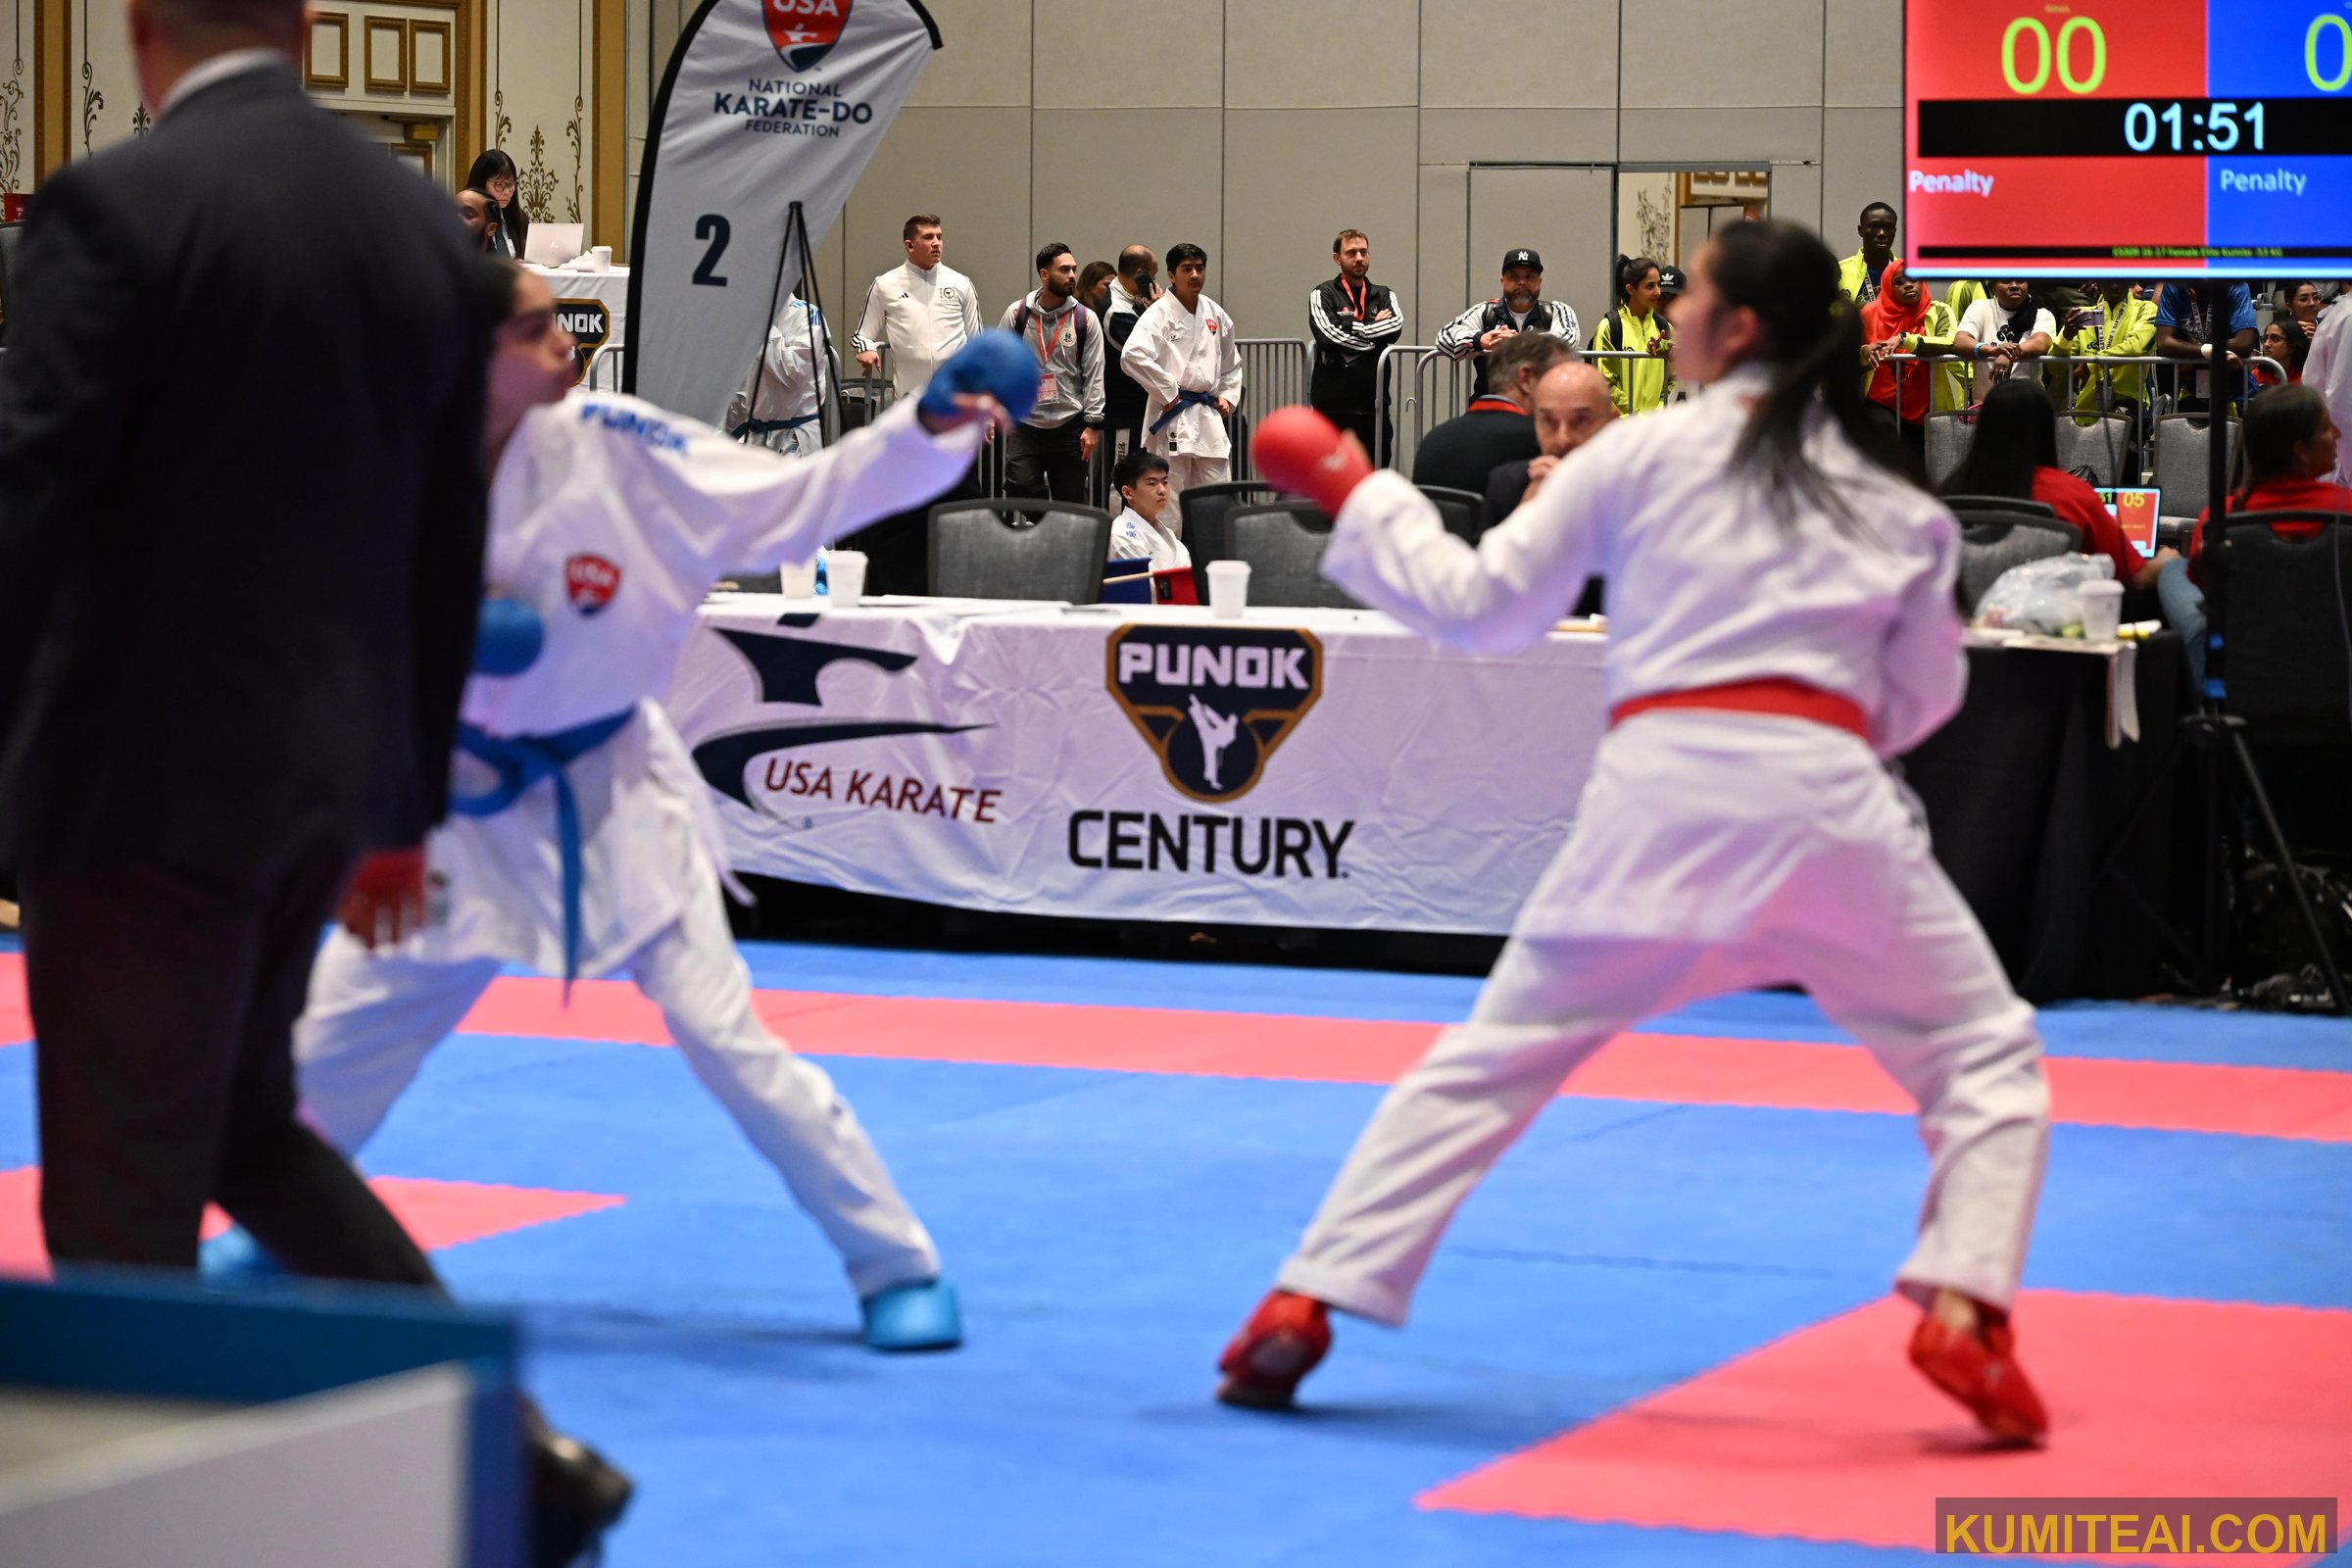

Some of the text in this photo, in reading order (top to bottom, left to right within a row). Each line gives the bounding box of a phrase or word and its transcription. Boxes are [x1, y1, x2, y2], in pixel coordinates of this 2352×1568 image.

[773, 0, 839, 18] USA
[2001, 16, 2107, 95] 00
[749, 78, 843, 98] NATIONAL
[713, 92, 873, 124] KARATE-DO
[745, 119, 840, 137] FEDERATION
[2124, 102, 2265, 152] 01:51
[1909, 169, 1993, 197] Penalty
[2221, 168, 2307, 196] Penalty
[692, 214, 731, 287] 2
[555, 313, 604, 333] NOK
[2123, 493, 2145, 508] 05
[1118, 642, 1310, 690] PUNOK
[765, 758, 1004, 824] USA KARATE
[1068, 809, 1354, 878] CENTURY
